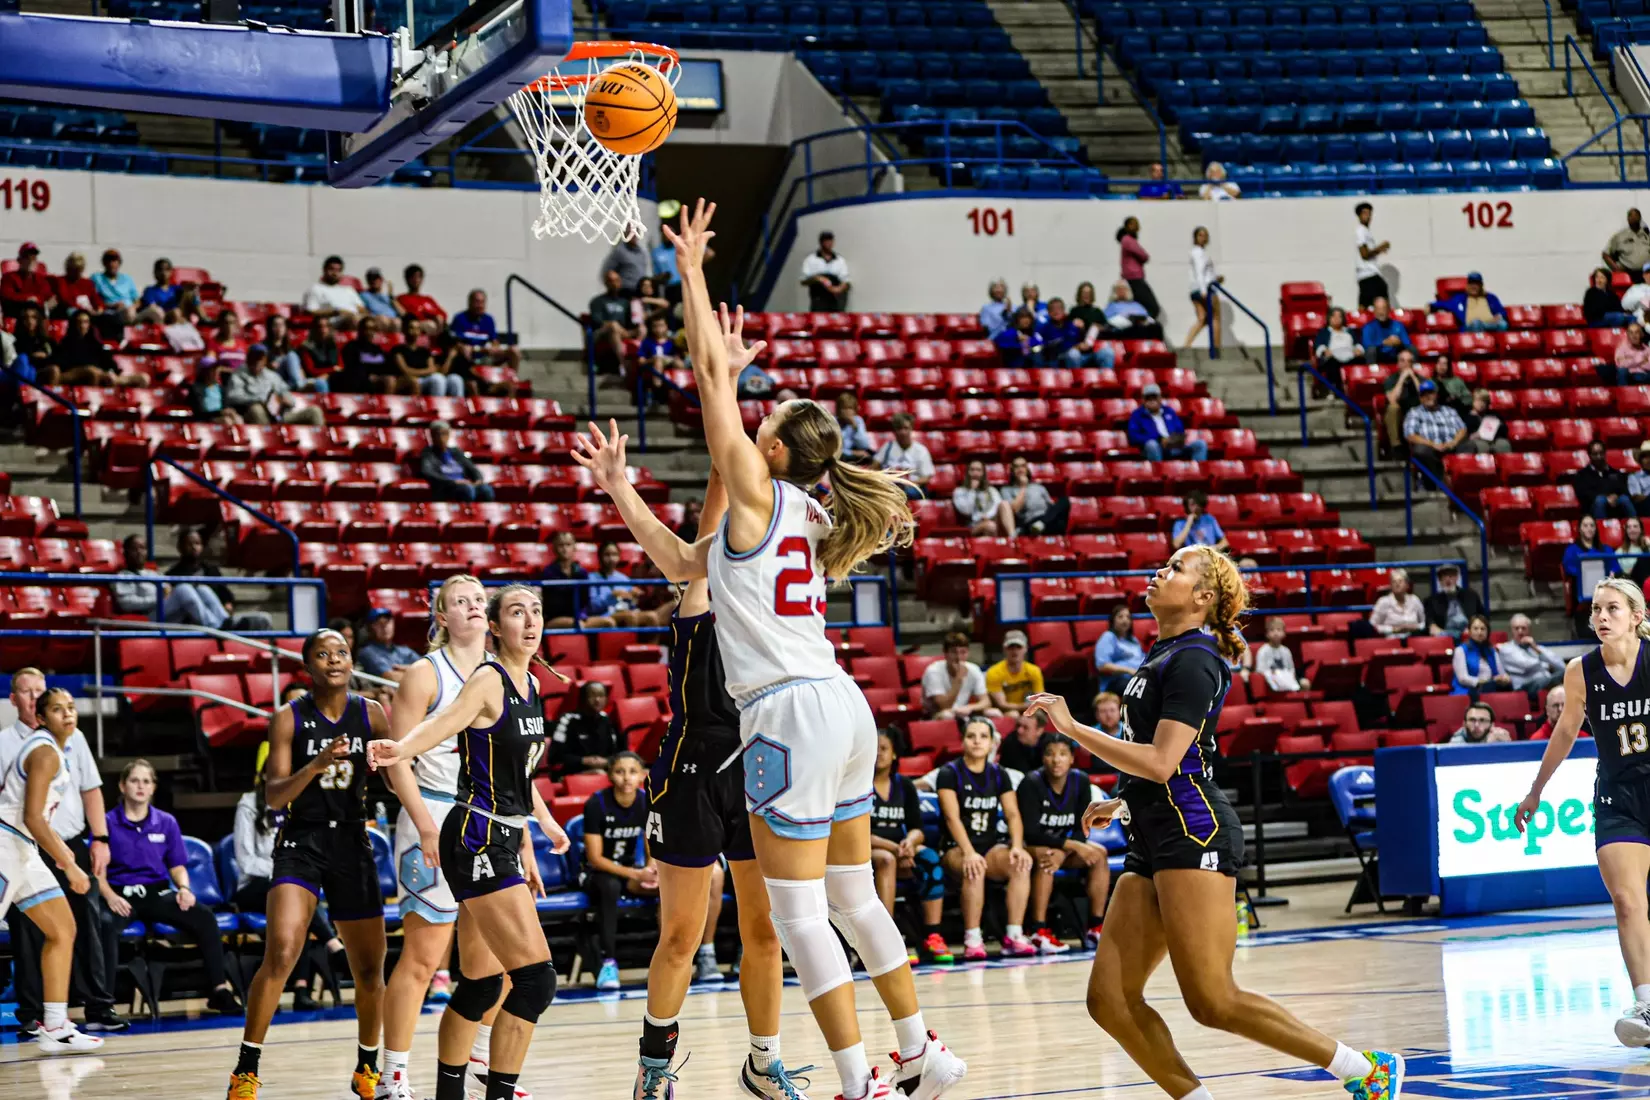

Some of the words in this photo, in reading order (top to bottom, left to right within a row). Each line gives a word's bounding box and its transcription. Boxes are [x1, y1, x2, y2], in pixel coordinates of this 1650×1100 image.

[0, 178, 51, 212] 119
[966, 206, 1014, 237] 101
[1461, 200, 1514, 229] 102
[775, 536, 828, 617] 2
[306, 736, 364, 756] LSA
[1616, 722, 1649, 757] 13
[319, 759, 354, 790] 23
[613, 841, 626, 859] 5
